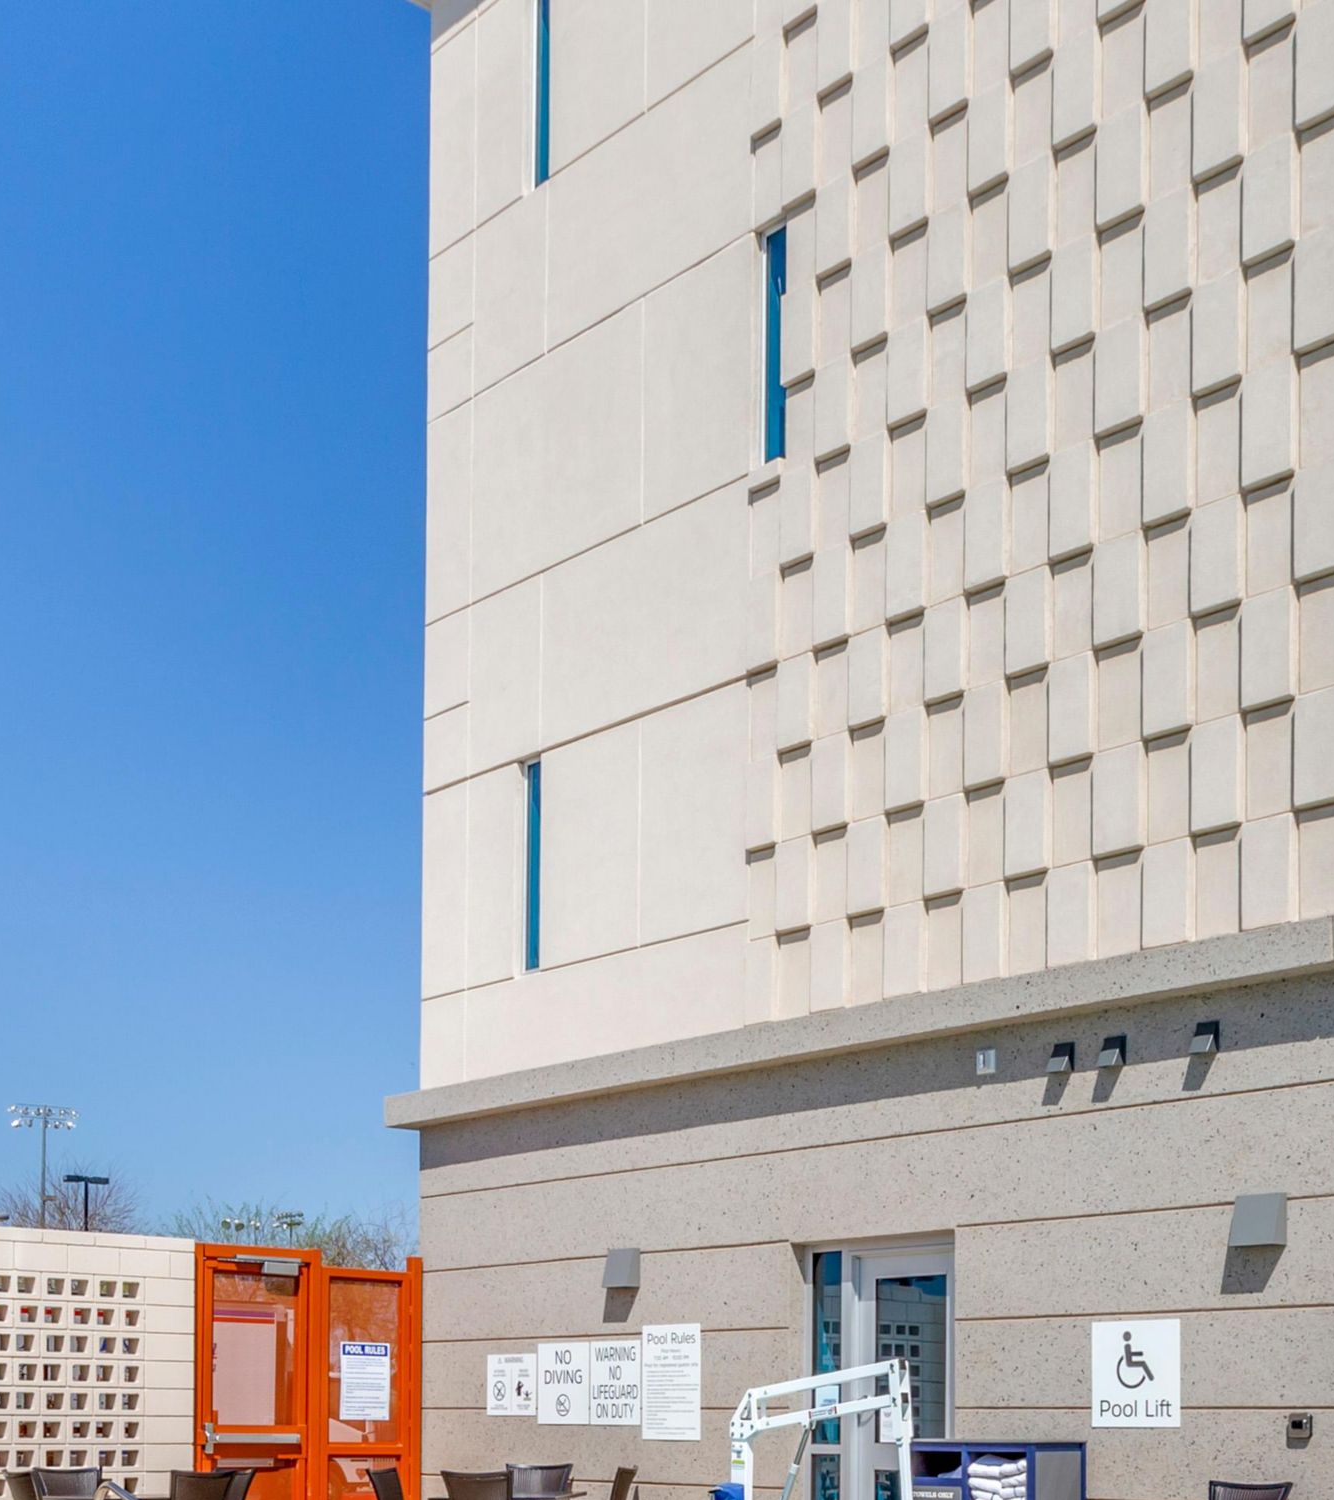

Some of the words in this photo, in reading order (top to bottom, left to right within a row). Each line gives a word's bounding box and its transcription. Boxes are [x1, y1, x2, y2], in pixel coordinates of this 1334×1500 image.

[647, 1333, 668, 1345] Pool
[671, 1332, 697, 1344] Rules
[345, 1345, 363, 1354] POOL
[364, 1346, 385, 1355] RULES
[555, 1349, 572, 1365] NO
[594, 1346, 637, 1362] WARNING
[544, 1369, 583, 1385] DIVING
[608, 1365, 622, 1380] NO
[592, 1384, 639, 1400] LIFEGUARD
[595, 1403, 609, 1419] ON
[611, 1403, 635, 1419] DUTY
[1100, 1400, 1138, 1417] Pool
[1145, 1399, 1172, 1417] Lift
